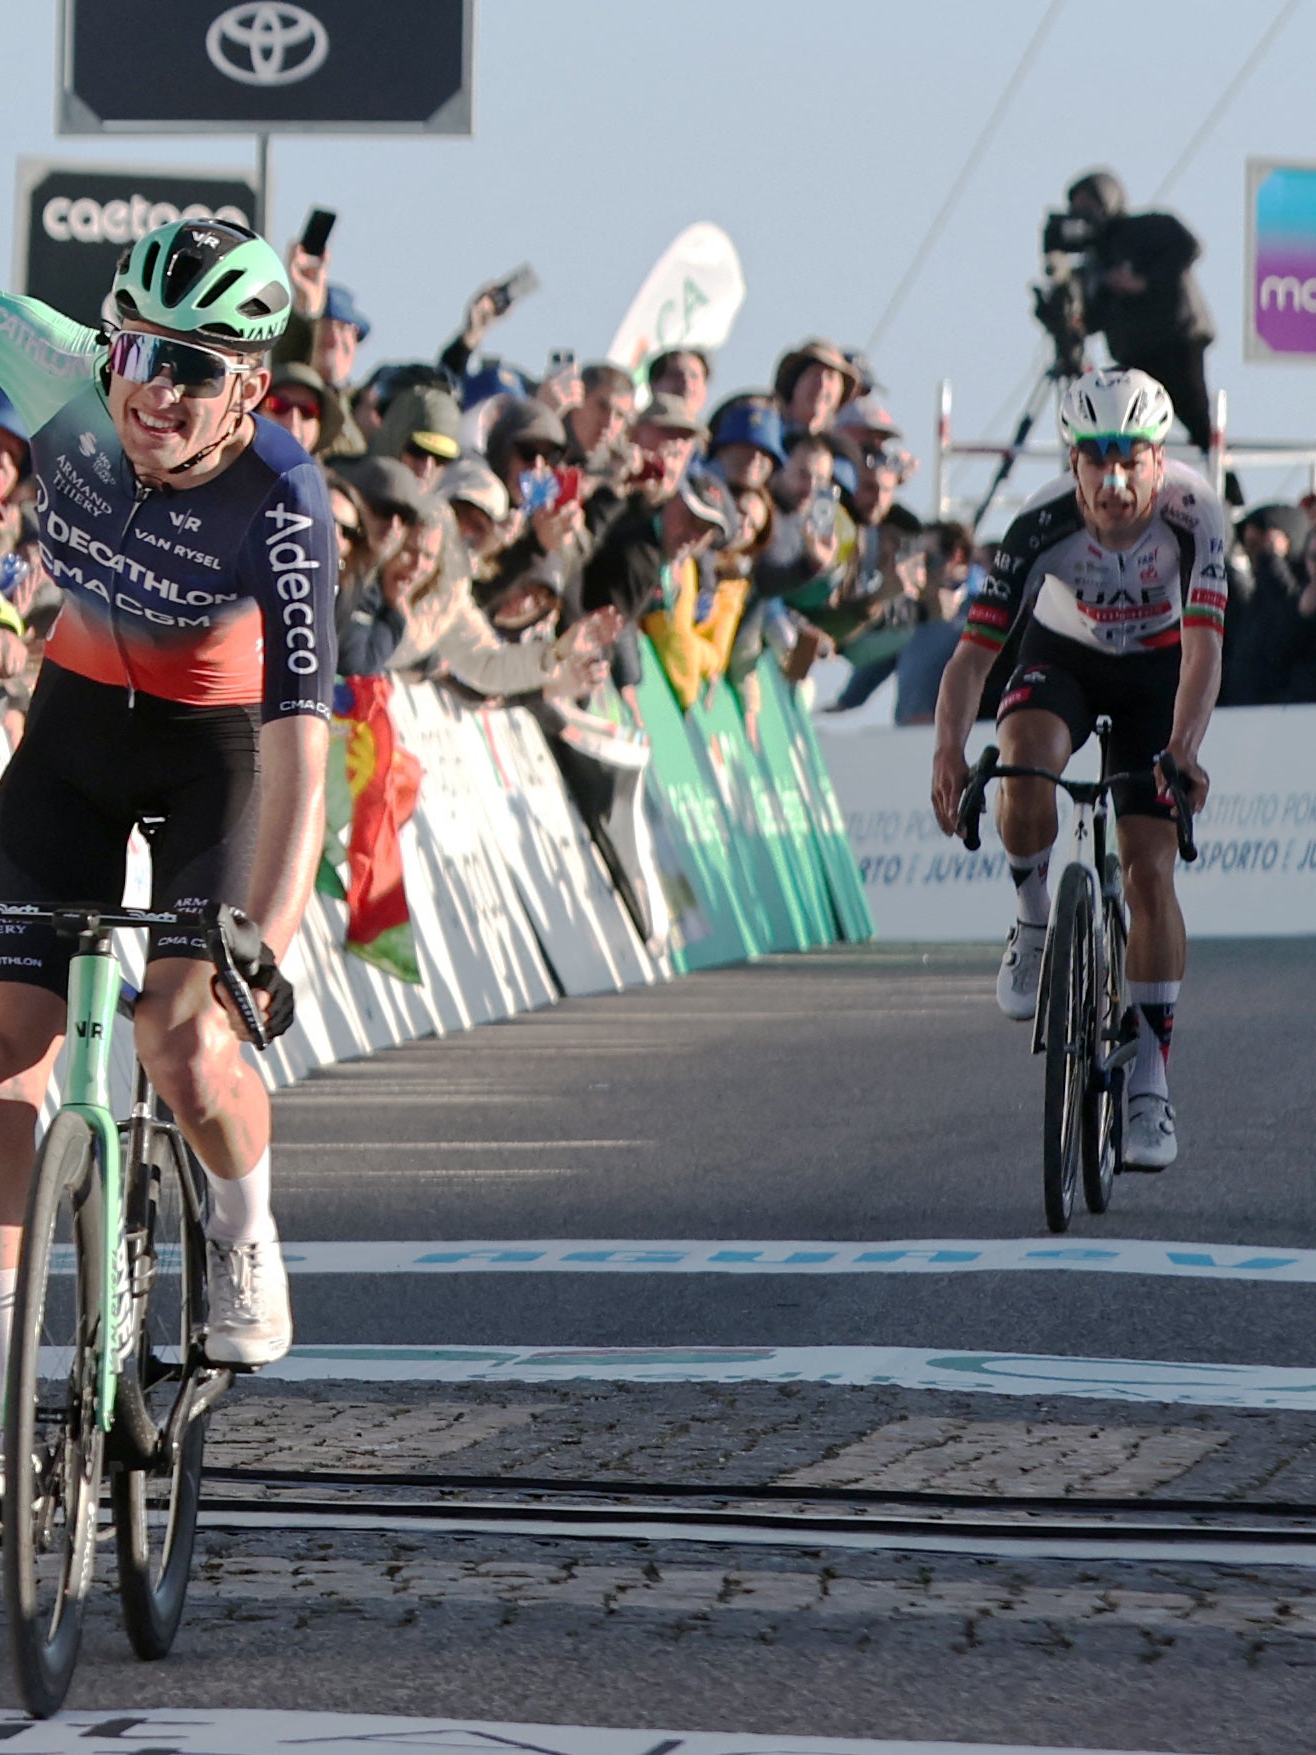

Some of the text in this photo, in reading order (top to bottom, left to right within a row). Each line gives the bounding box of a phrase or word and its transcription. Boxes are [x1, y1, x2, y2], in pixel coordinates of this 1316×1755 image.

[53, 470, 102, 518] THIERY
[56, 454, 112, 514] ARMAND
[38, 541, 212, 628] CMA CGM
[47, 513, 237, 606] DECATHLON
[135, 528, 222, 571] VAN RYSEL
[265, 502, 321, 675] Adecco
